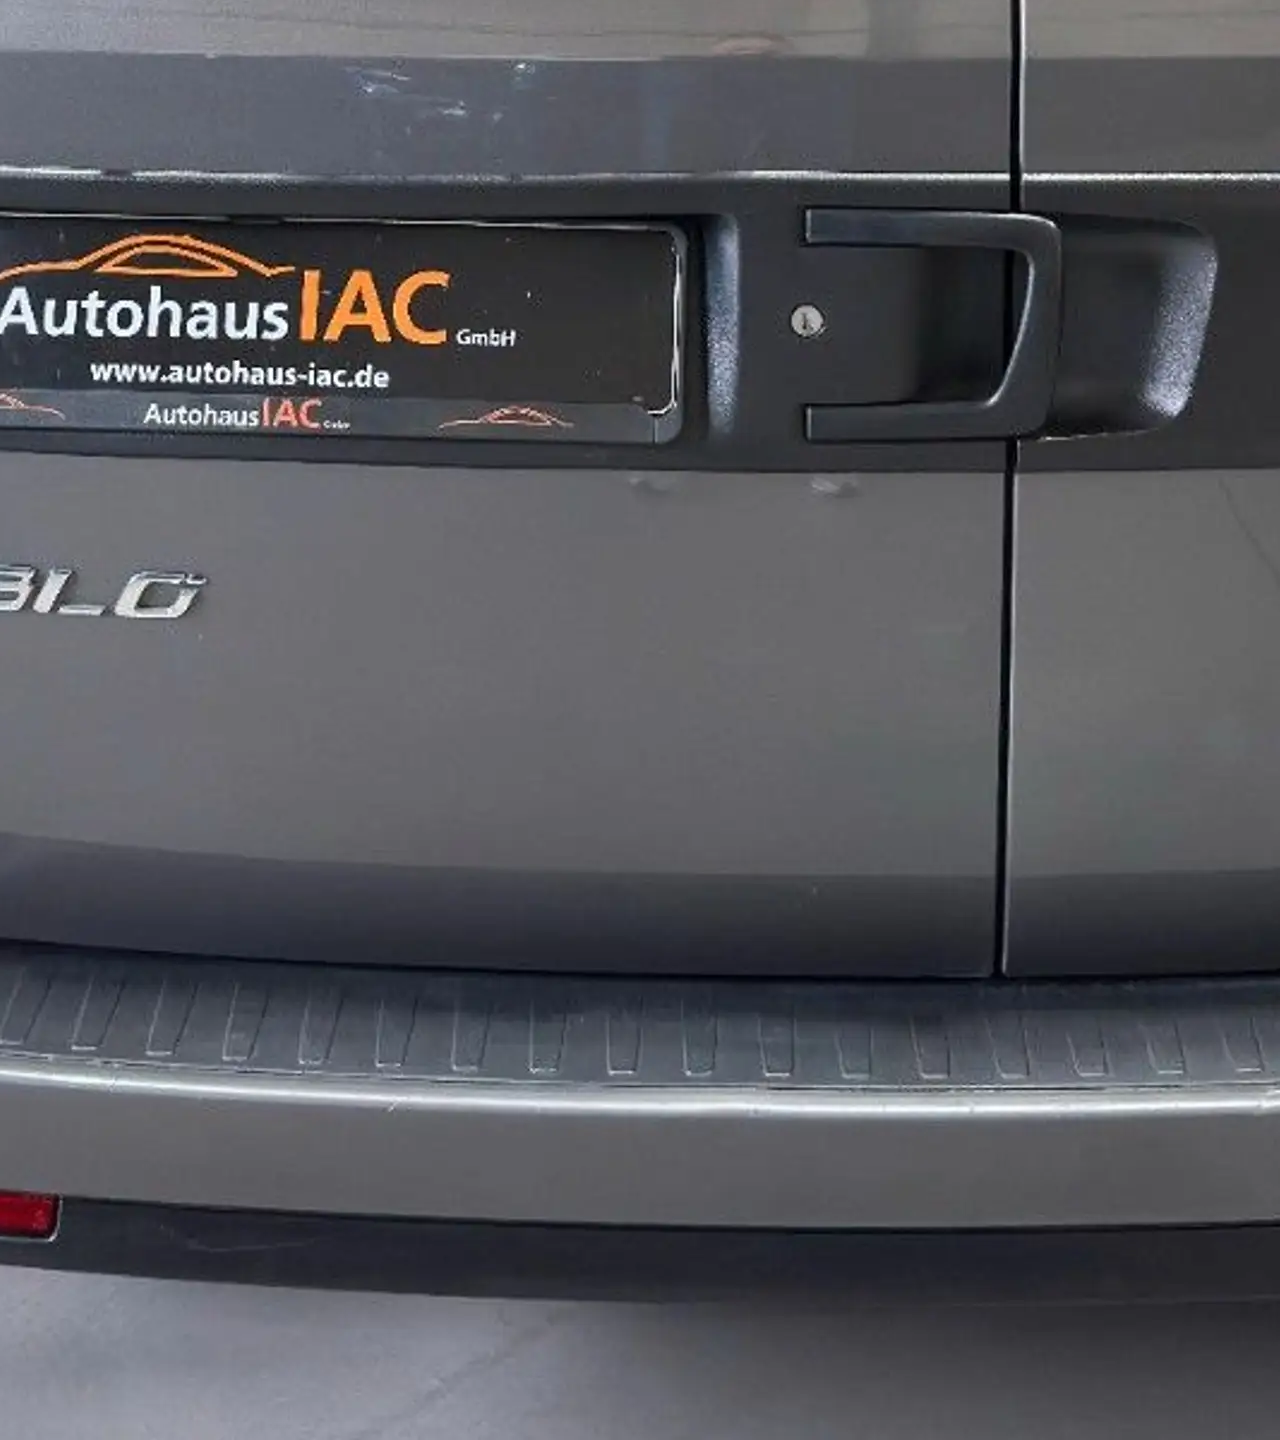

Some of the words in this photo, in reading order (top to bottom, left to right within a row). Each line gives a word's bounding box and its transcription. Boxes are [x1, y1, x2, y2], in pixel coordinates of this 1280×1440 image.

[299, 269, 451, 345] IAC
[456, 327, 517, 348] GmbH
[90, 360, 391, 389] www.autohaus-iac.de
